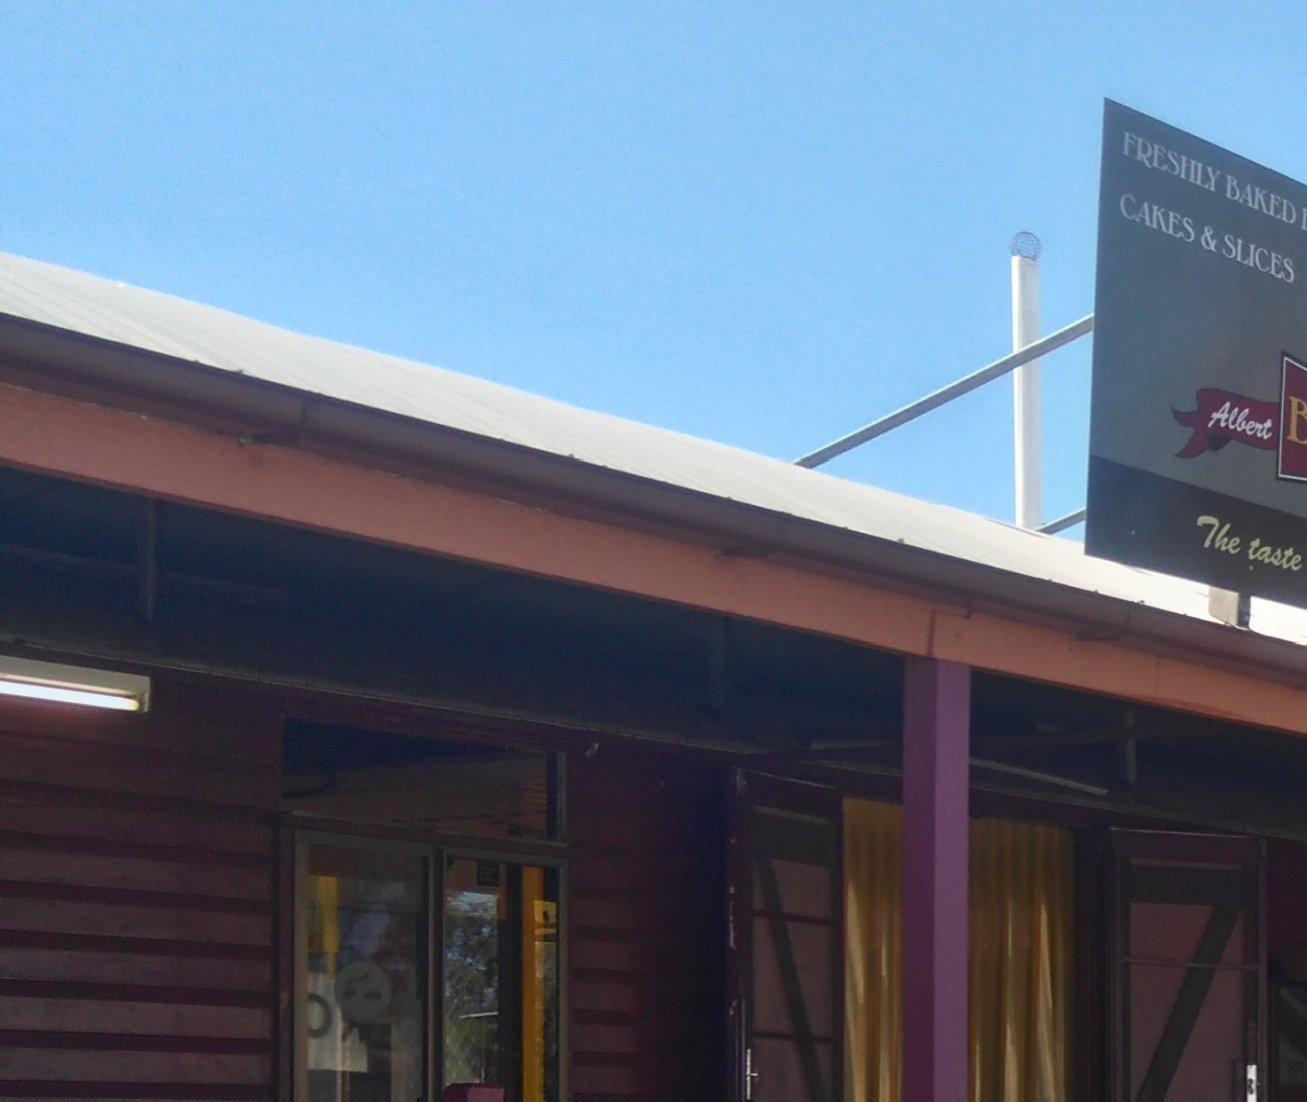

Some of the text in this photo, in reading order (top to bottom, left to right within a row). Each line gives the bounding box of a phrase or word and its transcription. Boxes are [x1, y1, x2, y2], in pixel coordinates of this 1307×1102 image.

[1123, 131, 1220, 192] FRESHLY
[1226, 175, 1296, 224] BAKED
[1119, 194, 1295, 283] CAKES & SLICES
[1208, 401, 1272, 440] Albert
[1197, 515, 1241, 554] The
[1248, 538, 1303, 571] taste
